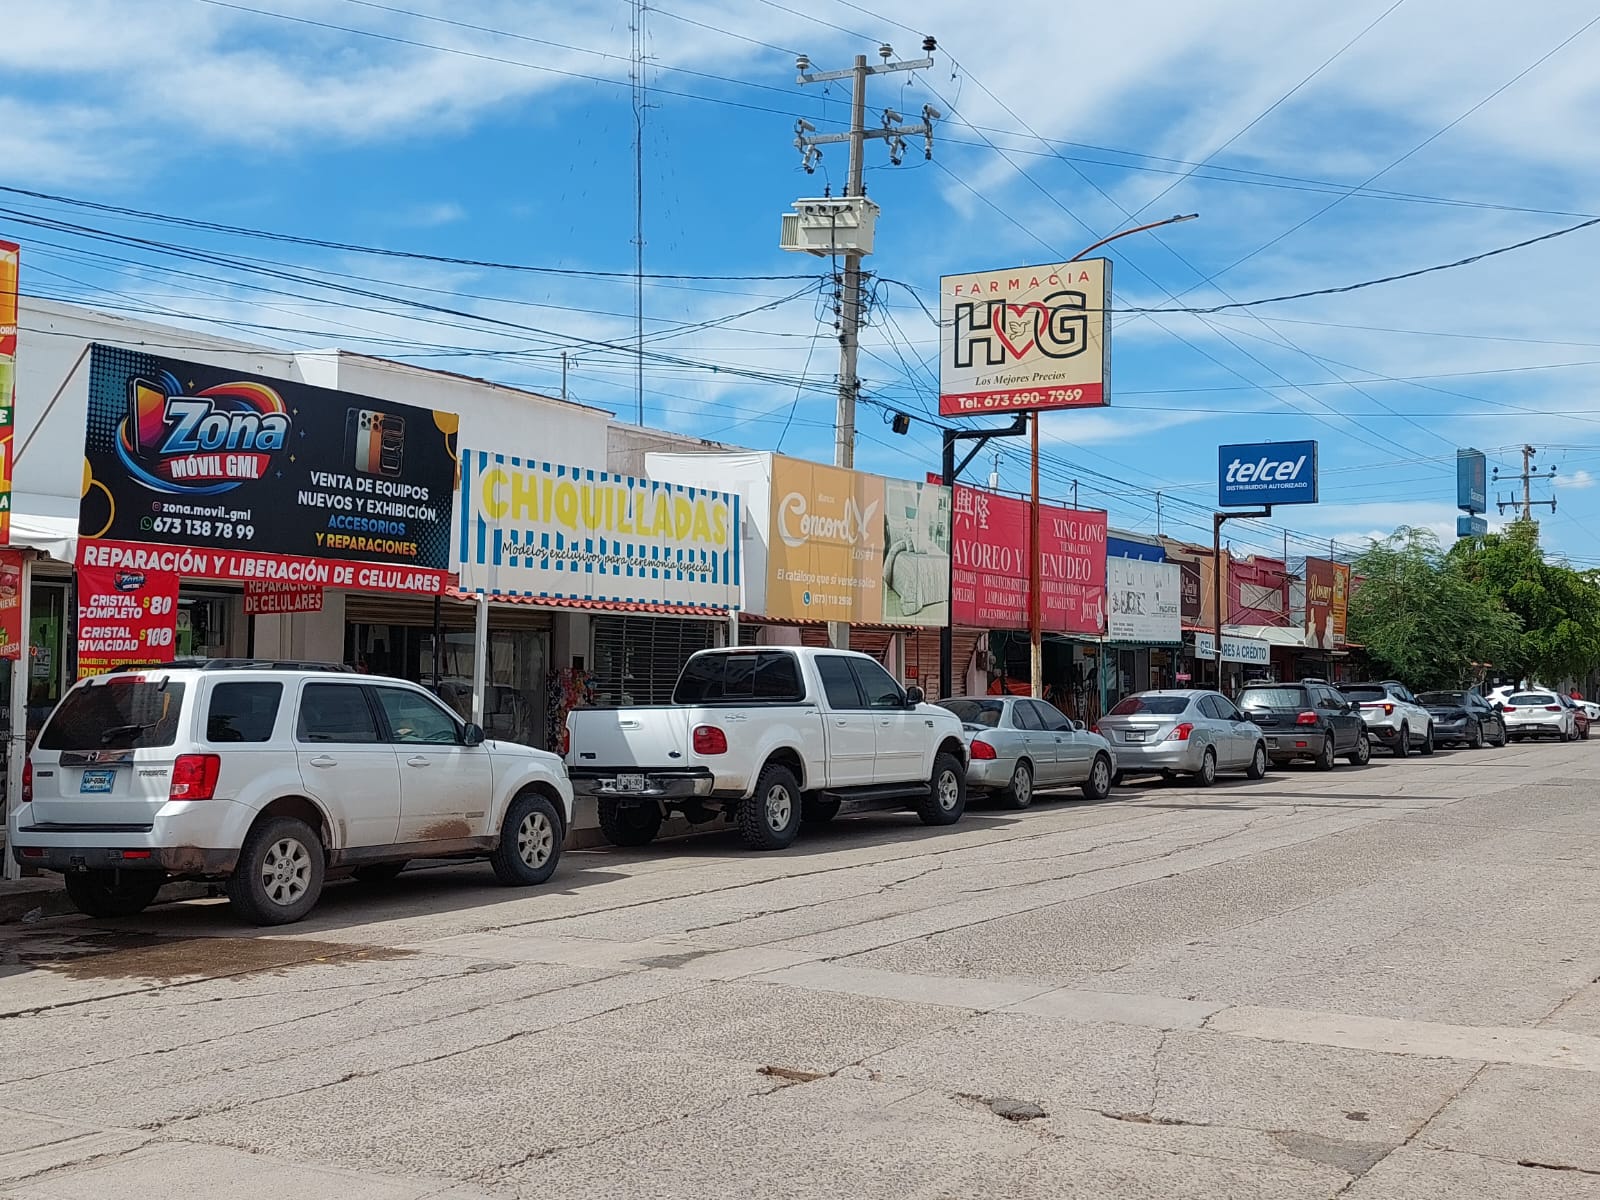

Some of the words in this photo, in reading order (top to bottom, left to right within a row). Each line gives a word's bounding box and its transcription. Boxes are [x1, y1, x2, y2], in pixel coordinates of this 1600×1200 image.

[955, 271, 1089, 296] FARMACIA
[0, 326, 16, 335] ORIA
[975, 377, 991, 386] Los
[993, 374, 1030, 386] Mejores
[1032, 371, 1066, 382] Precios
[958, 397, 981, 409] Tel.
[984, 395, 1010, 407] 673
[1048, 388, 1083, 402] 7969
[159, 400, 289, 454] Zona
[170, 455, 222, 479] MÓVIL
[226, 456, 259, 479] GML
[1226, 456, 1307, 483] telcel
[310, 471, 353, 490] VENTA
[356, 477, 373, 493] DE
[375, 480, 429, 501] EQUIPOS
[1226, 484, 1268, 492] DISTRIBUIDOR
[1268, 482, 1308, 490] AUTORIZADO
[162, 503, 251, 521] zona.movil_gml
[298, 490, 352, 510] NUEVOS
[355, 498, 365, 512] Y
[366, 500, 439, 523] EXHIBICIÓN,
[482, 468, 727, 545] CHIQUILLADAS
[153, 516, 182, 534] 673
[185, 520, 211, 536] 138
[214, 522, 233, 538] 78
[236, 524, 255, 540] 99
[328, 514, 406, 536] ACCESORIOS
[1053, 518, 1077, 542] XING
[1078, 522, 1105, 544] LONG
[316, 532, 325, 546] Y
[327, 534, 418, 556] REPARACIONES
[502, 542, 547, 558] Modelos
[550, 547, 603, 563] exclusivos
[604, 555, 627, 567] para
[629, 557, 677, 569] ceremonia
[679, 561, 713, 574] especial
[953, 541, 1011, 573] AYOREO
[1014, 548, 1024, 573] Y
[1041, 552, 1092, 582] ENUDEO
[84, 545, 207, 573] REPARACIÓN
[213, 556, 226, 574] Y
[229, 557, 329, 583] LIBERACIÓN
[333, 566, 355, 585] DE
[358, 568, 441, 592] CELULARES
[776, 568, 784, 580] El
[816, 575, 829, 587] que
[952, 569, 977, 585] OVEDADES
[90, 594, 138, 607] CRISTAL
[143, 596, 173, 615] $80
[246, 596, 259, 612] DE
[260, 593, 322, 612] CELULARES
[952, 585, 976, 603] APELERÍA
[79, 606, 143, 619] COMPLETO
[81, 626, 132, 639] CRISTAL
[78, 639, 139, 652] RIVACIDAD
[1236, 644, 1241, 658] A
[1241, 643, 1267, 660] CRÉDITO
